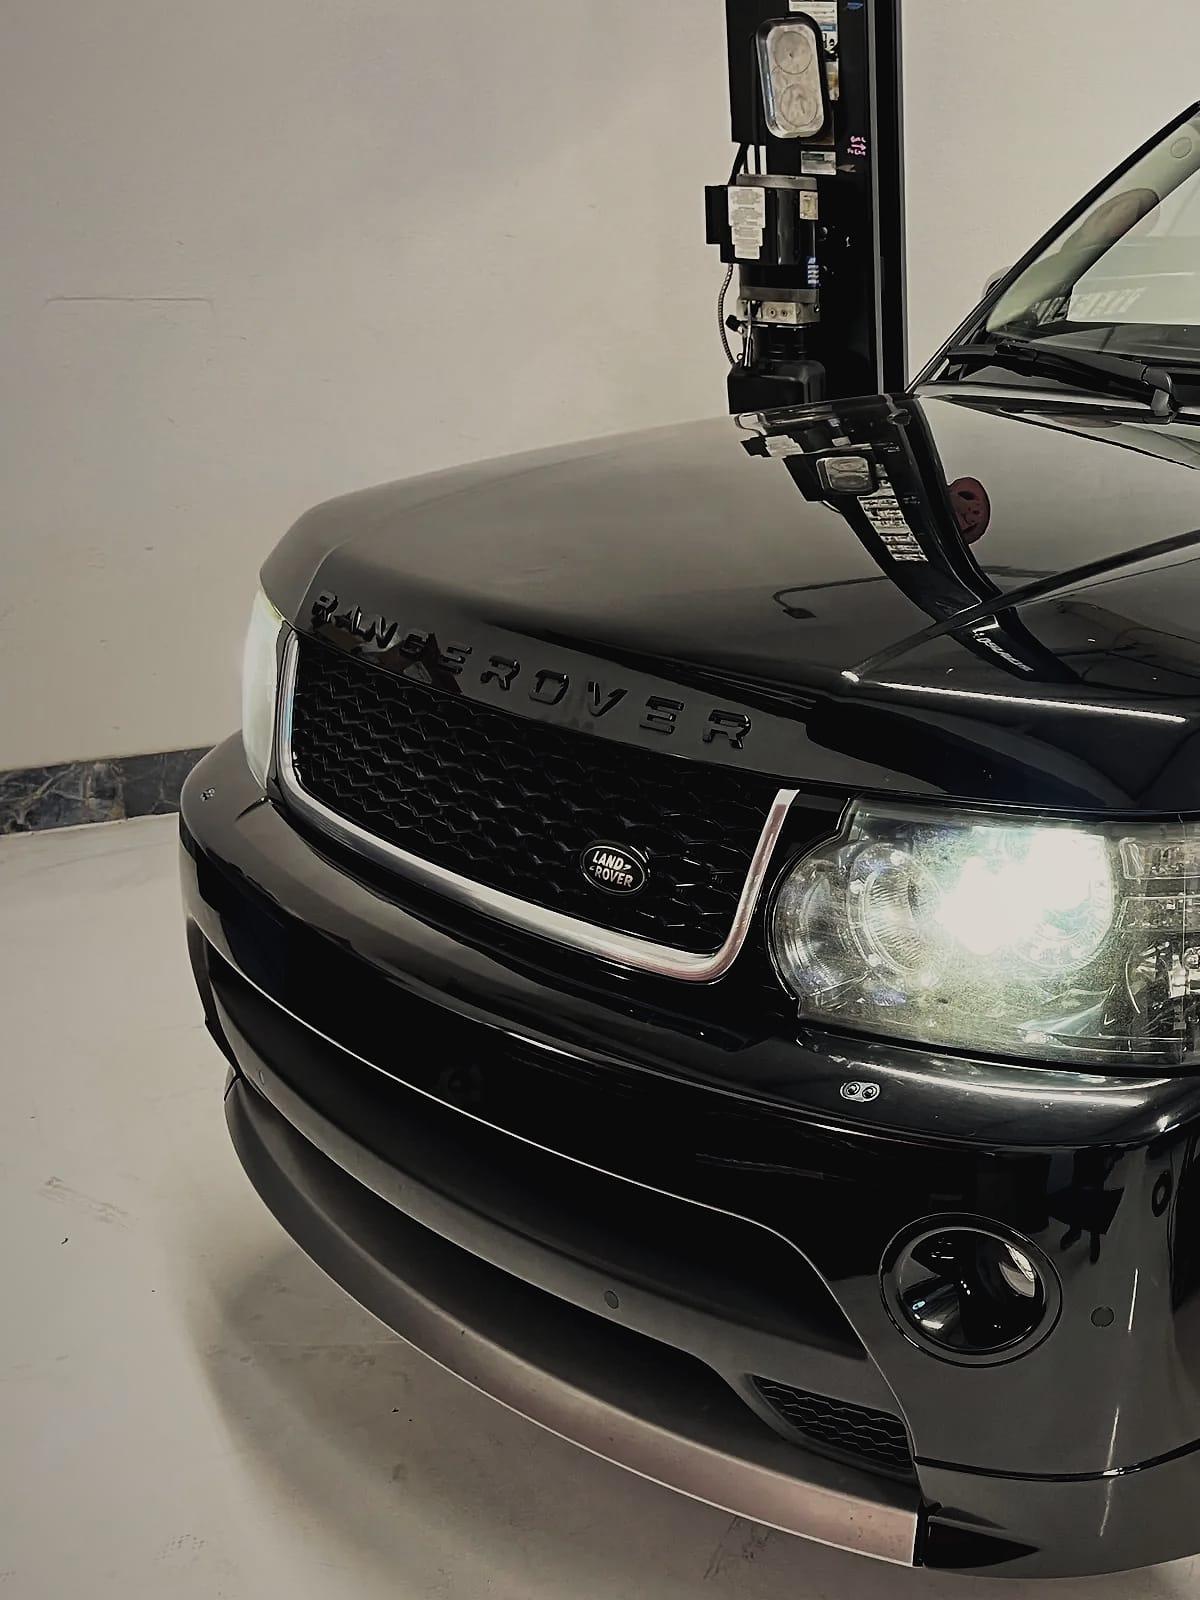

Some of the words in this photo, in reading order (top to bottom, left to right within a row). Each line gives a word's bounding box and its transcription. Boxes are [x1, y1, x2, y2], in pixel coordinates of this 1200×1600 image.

[311, 590, 473, 677] RANGE
[480, 655, 752, 750] ROVER
[592, 850, 625, 871] LAND
[594, 865, 633, 888] ROVER
